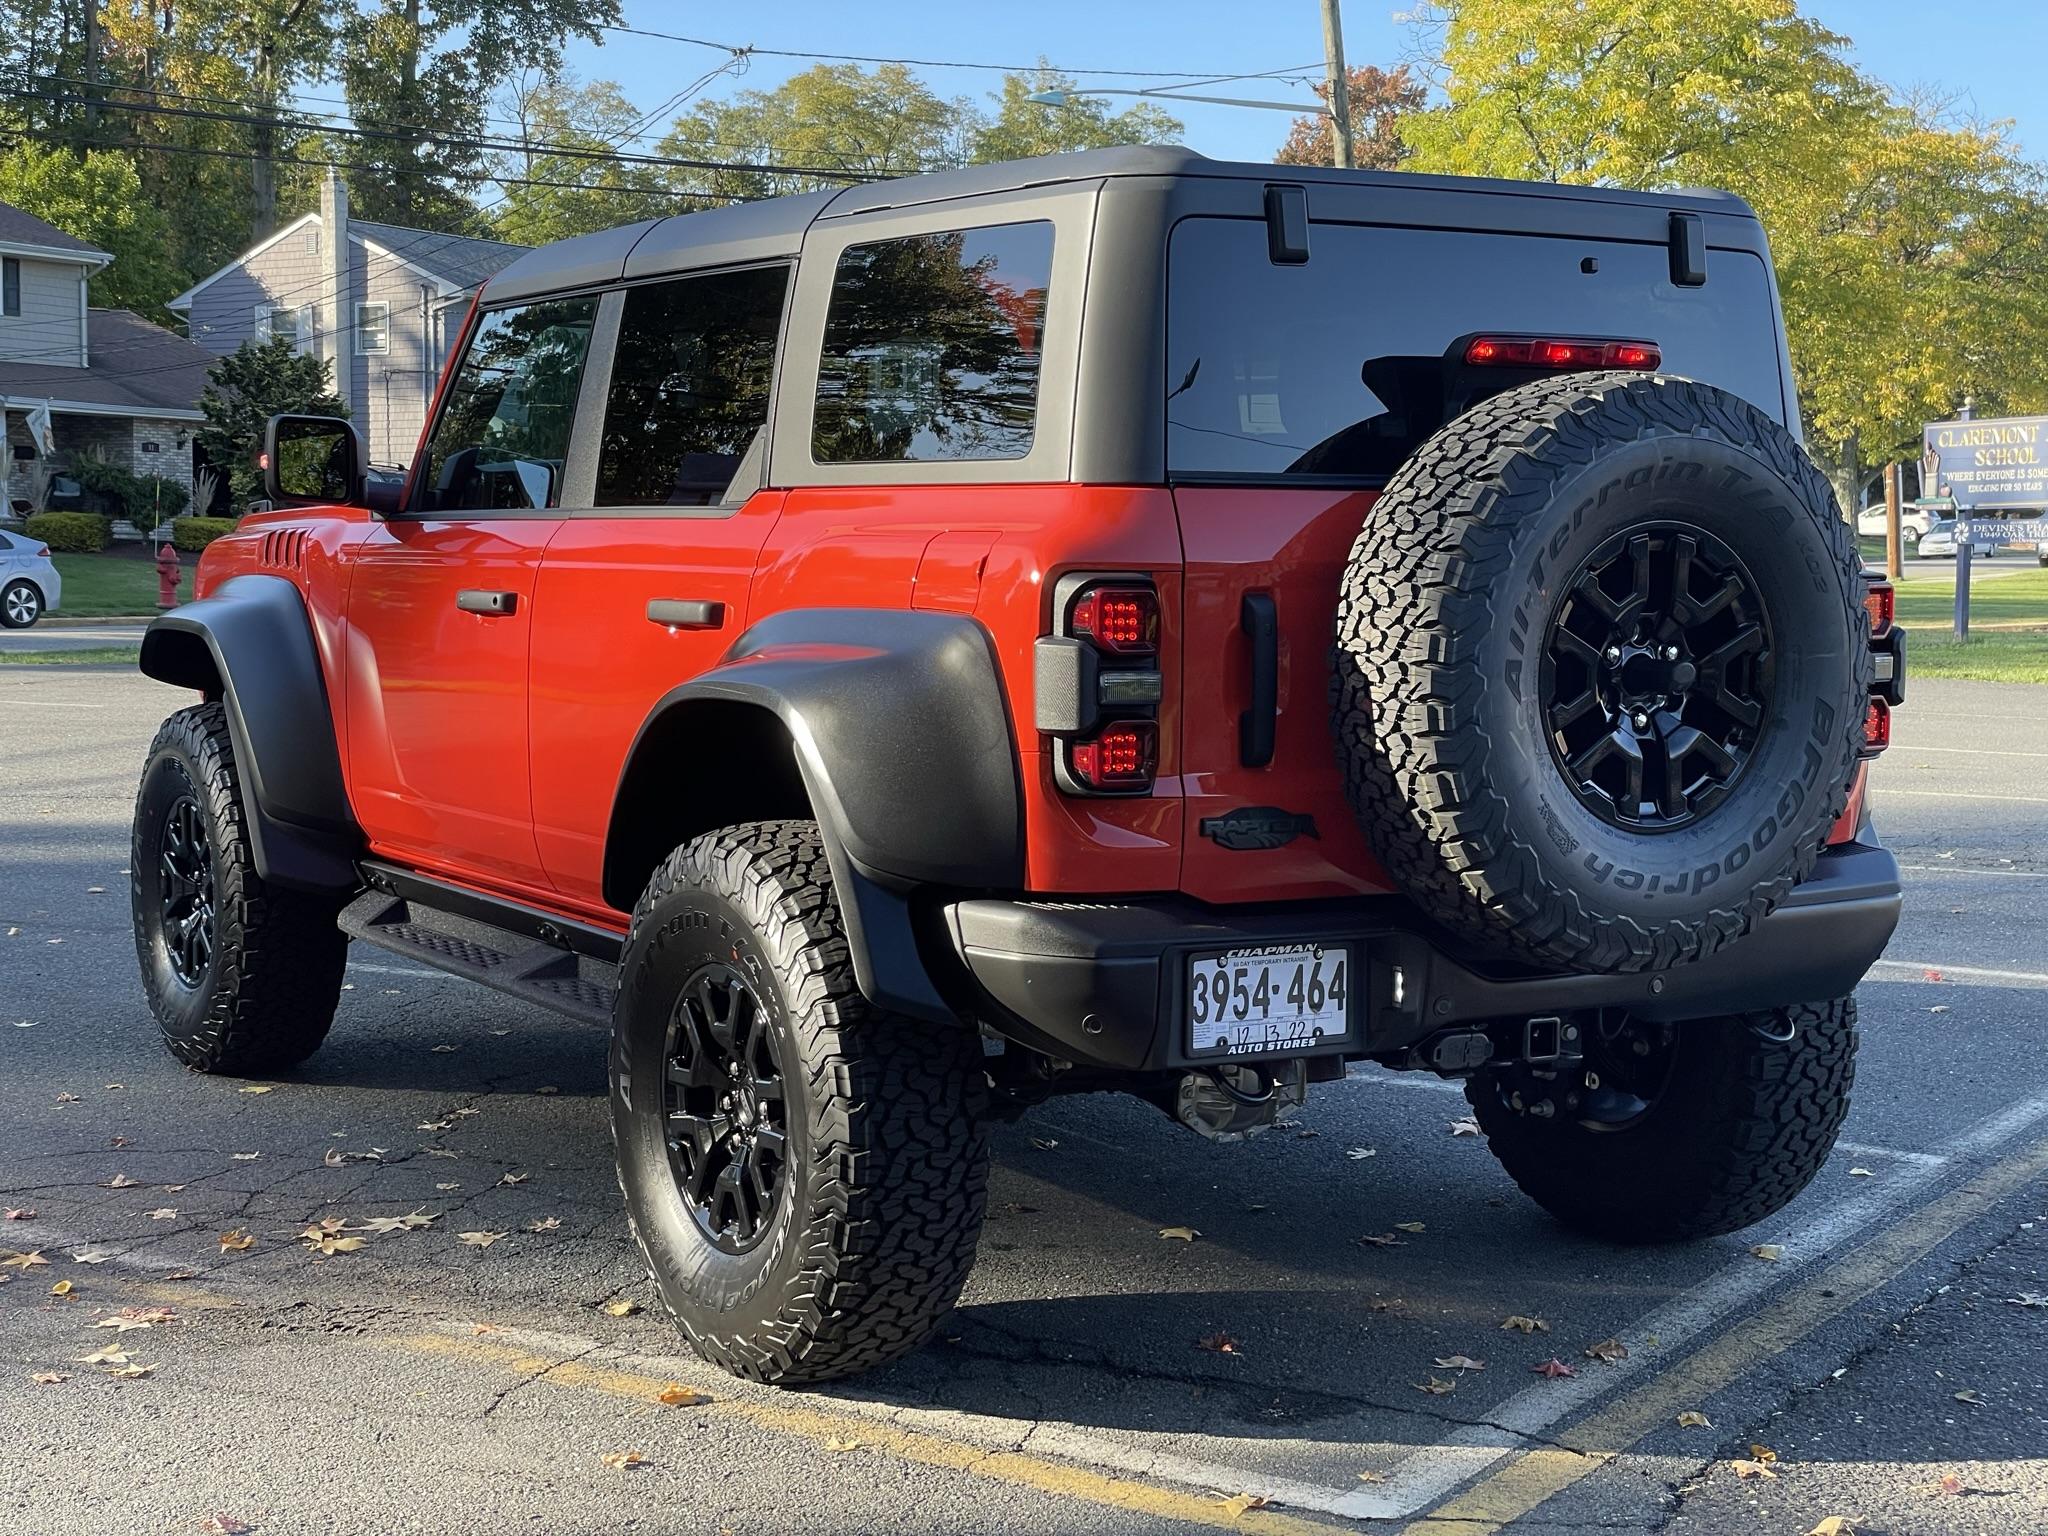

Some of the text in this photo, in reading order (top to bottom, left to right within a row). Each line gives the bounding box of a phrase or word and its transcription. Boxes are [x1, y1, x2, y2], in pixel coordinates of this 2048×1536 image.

[1938, 426, 2039, 447] CLAREMONT
[1975, 447, 2040, 466] SCHOOL
[1976, 469, 2016, 481] EVERYONE
[2017, 468, 2026, 479] IS
[2000, 483, 2012, 492] FOR
[1973, 524, 2024, 533] DEVINE'S
[2002, 530, 2025, 538] OAK
[1226, 943, 1318, 959] CHAPMAN
[1240, 960, 1251, 968] DAY
[1251, 958, 1282, 967] TEMPORARY
[1265, 1024, 1280, 1042] 13
[1288, 1021, 1306, 1039] 22
[1227, 1037, 1317, 1056] AUTO STORES
